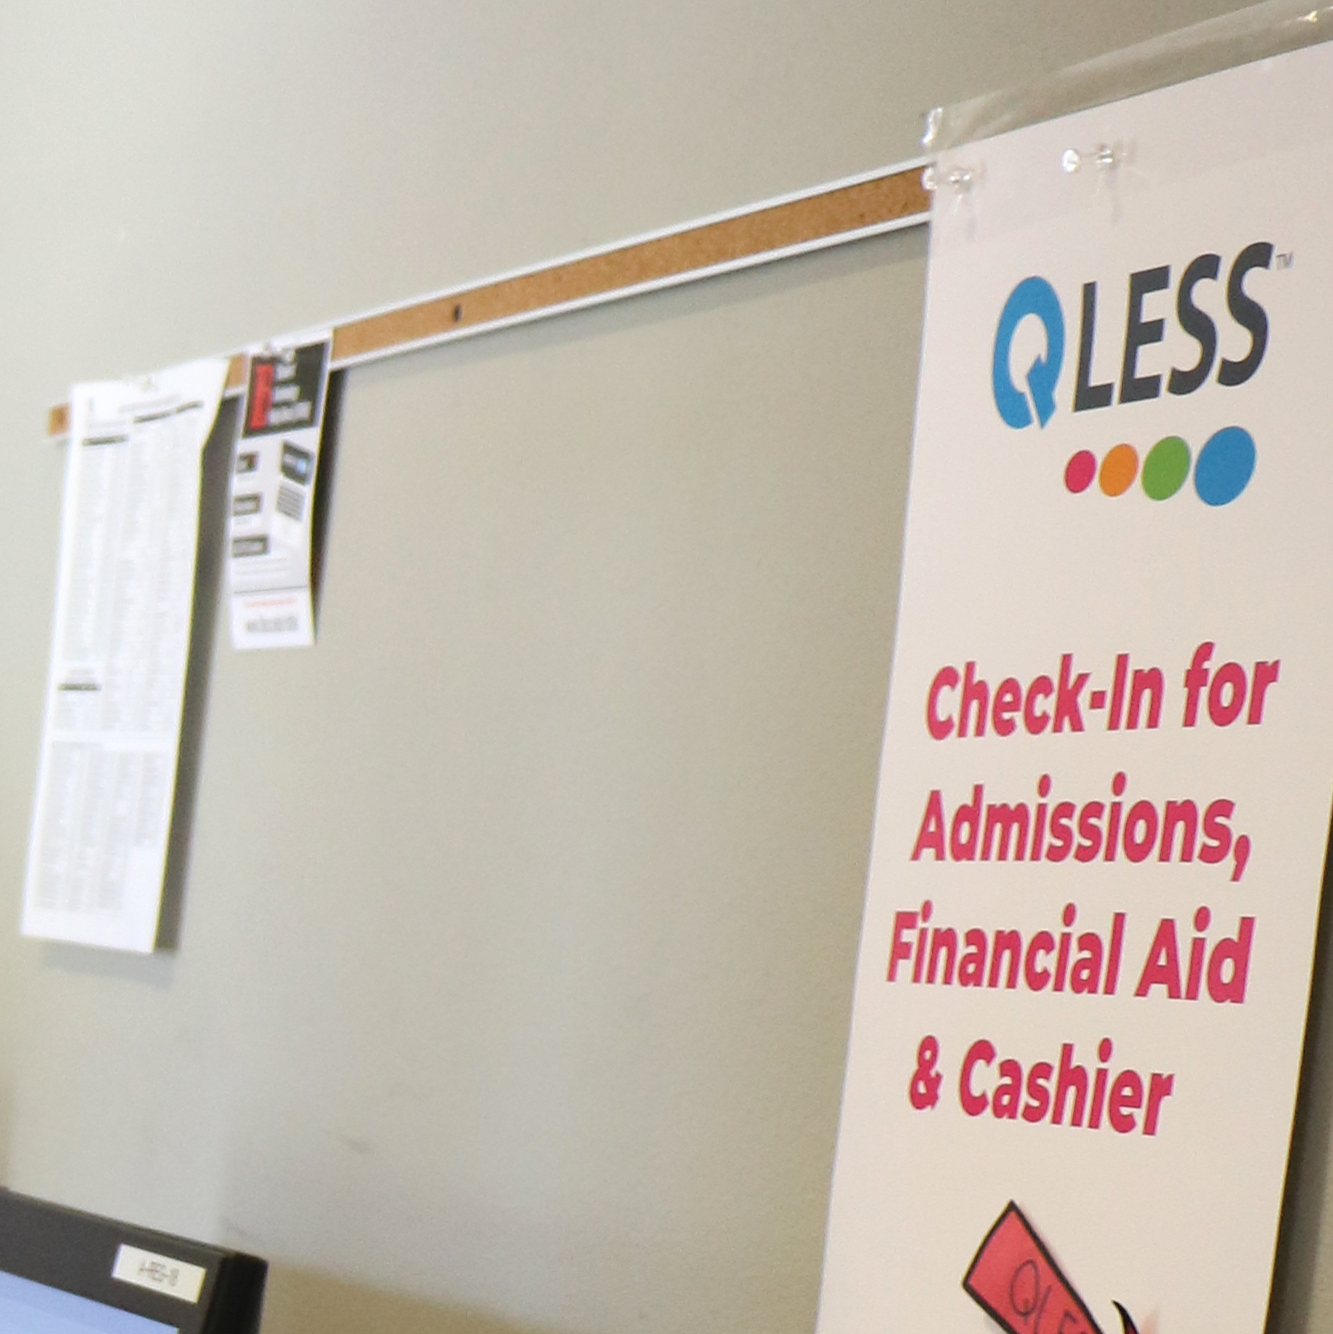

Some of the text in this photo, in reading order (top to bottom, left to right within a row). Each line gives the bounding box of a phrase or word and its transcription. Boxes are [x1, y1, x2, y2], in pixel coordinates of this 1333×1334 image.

[992, 241, 1274, 430] QLESS
[926, 641, 1281, 741] Check-In for
[910, 771, 1252, 882] Admissions,
[887, 900, 1256, 1004] Financial Aid
[909, 1035, 1175, 1136] & Cashier
